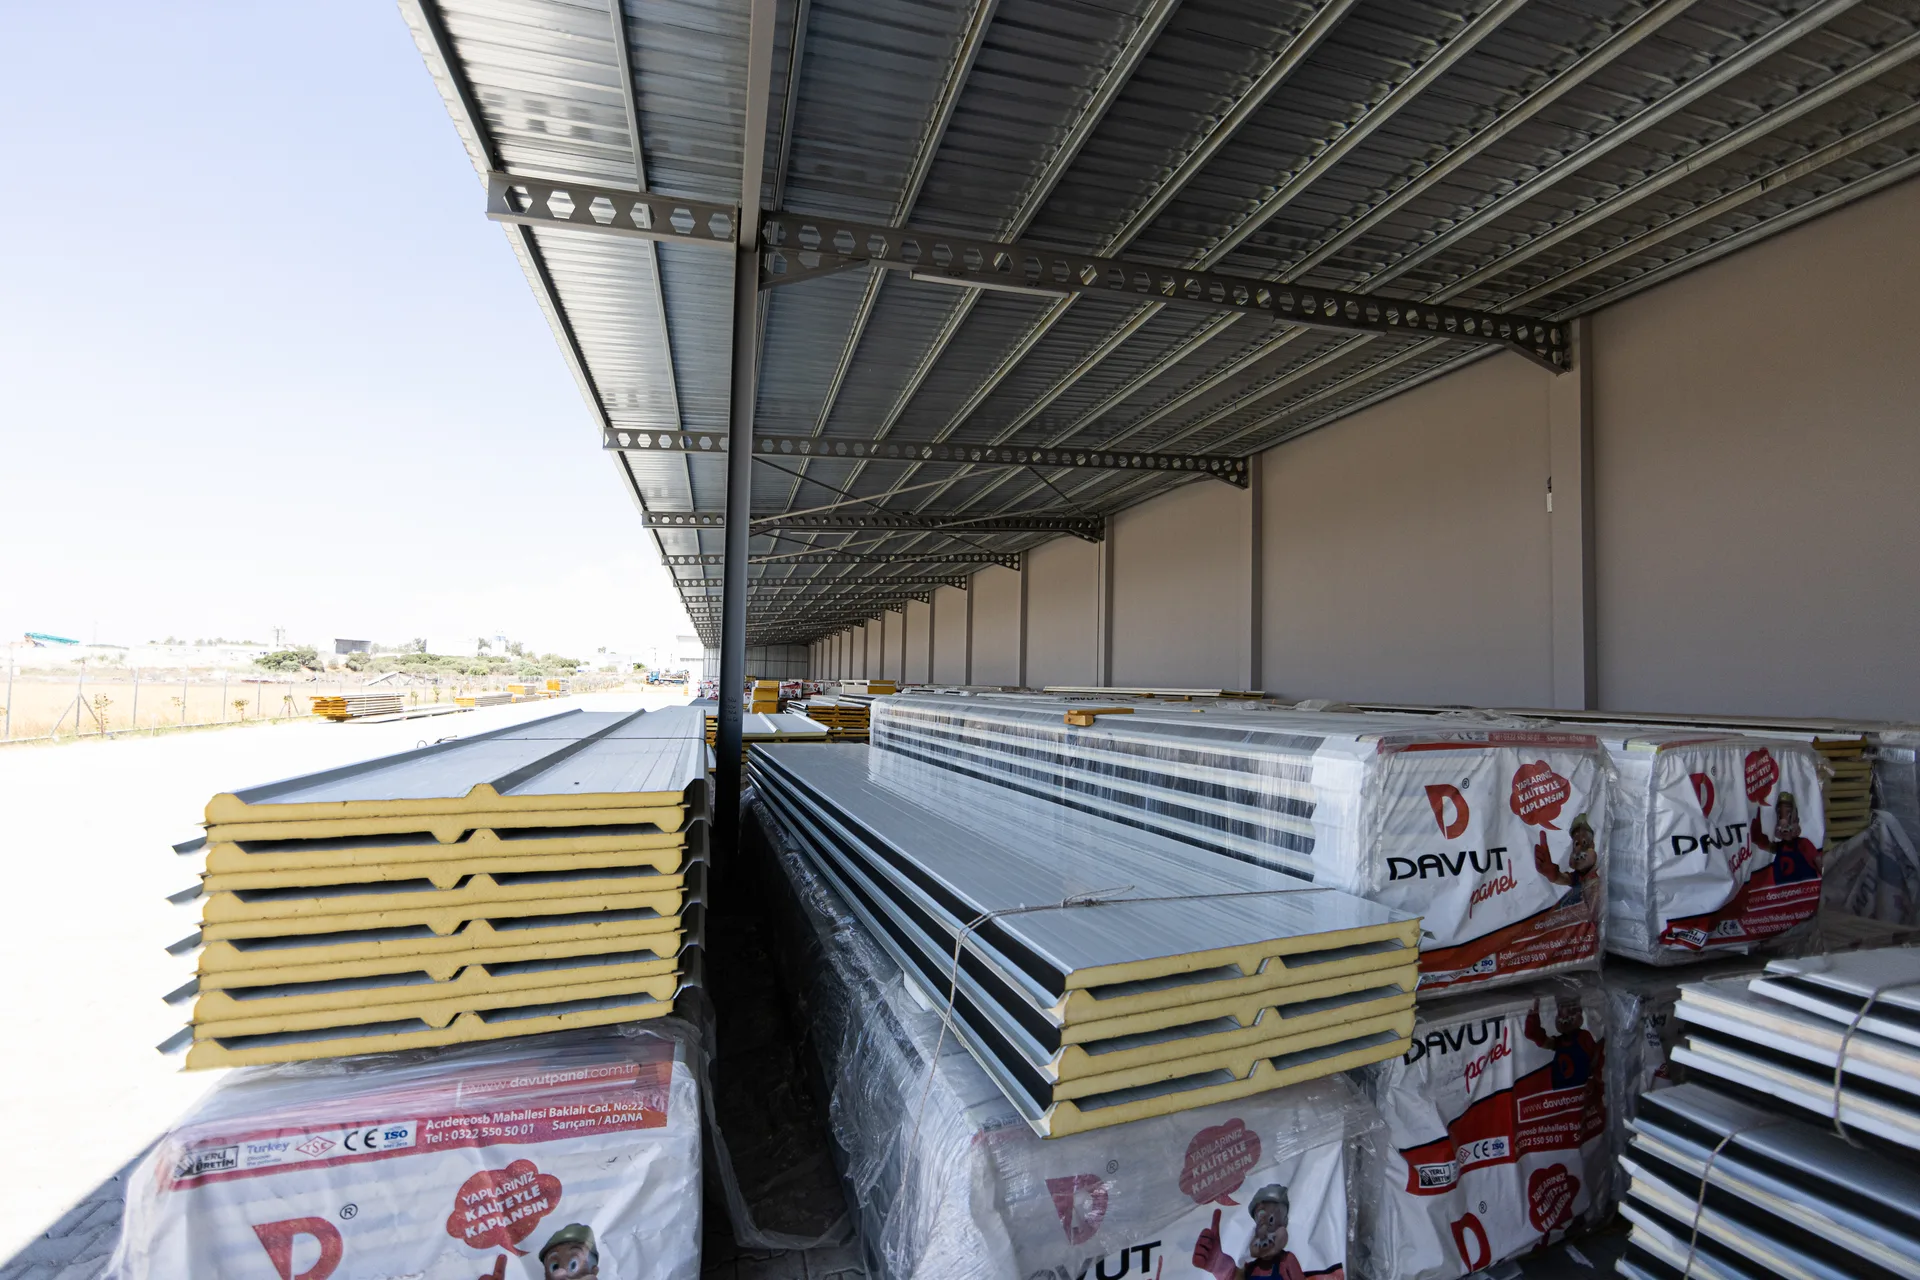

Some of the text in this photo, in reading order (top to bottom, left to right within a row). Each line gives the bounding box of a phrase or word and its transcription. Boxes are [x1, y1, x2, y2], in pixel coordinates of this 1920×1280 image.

[1519, 790, 1565, 816] KAPLANSIN
[1386, 847, 1508, 881] DAVUT
[1469, 858, 1518, 919] panel
[1403, 1015, 1506, 1066] DAVUT
[425, 1133, 442, 1144] Tel
[451, 1129, 479, 1141] 0322
[482, 1127, 502, 1138] 550
[504, 1125, 519, 1137] 50
[520, 1123, 535, 1135] 01
[552, 1119, 596, 1132] Sarıçam
[603, 1112, 643, 1126] ADANA
[426, 1113, 491, 1131] Acıdereosb
[493, 1109, 547, 1124] Mahallesi
[549, 1106, 587, 1118] Baklalı
[588, 1103, 612, 1114] Cad.
[1538, 1122, 1568, 1134] Mahallesi
[247, 1142, 290, 1155] Turkey
[344, 1128, 378, 1151] CE
[384, 1129, 409, 1141] ISO
[1190, 1128, 1244, 1163] YAPILARINIZ
[1473, 1140, 1490, 1159] CE
[1492, 1142, 1505, 1150] ISO
[1533, 1136, 1545, 1146] 550
[1545, 1135, 1554, 1144] 50
[1554, 1134, 1563, 1143] 01
[1192, 1140, 1247, 1178] KALİTEYLE
[1192, 1154, 1253, 1194] KAPLANSIN
[1428, 1168, 1446, 1176] YERLİ
[462, 1171, 536, 1206] YAPILARINIZ
[465, 1185, 541, 1222] KALİTEYLE
[465, 1198, 549, 1238] KAPLANSIN
